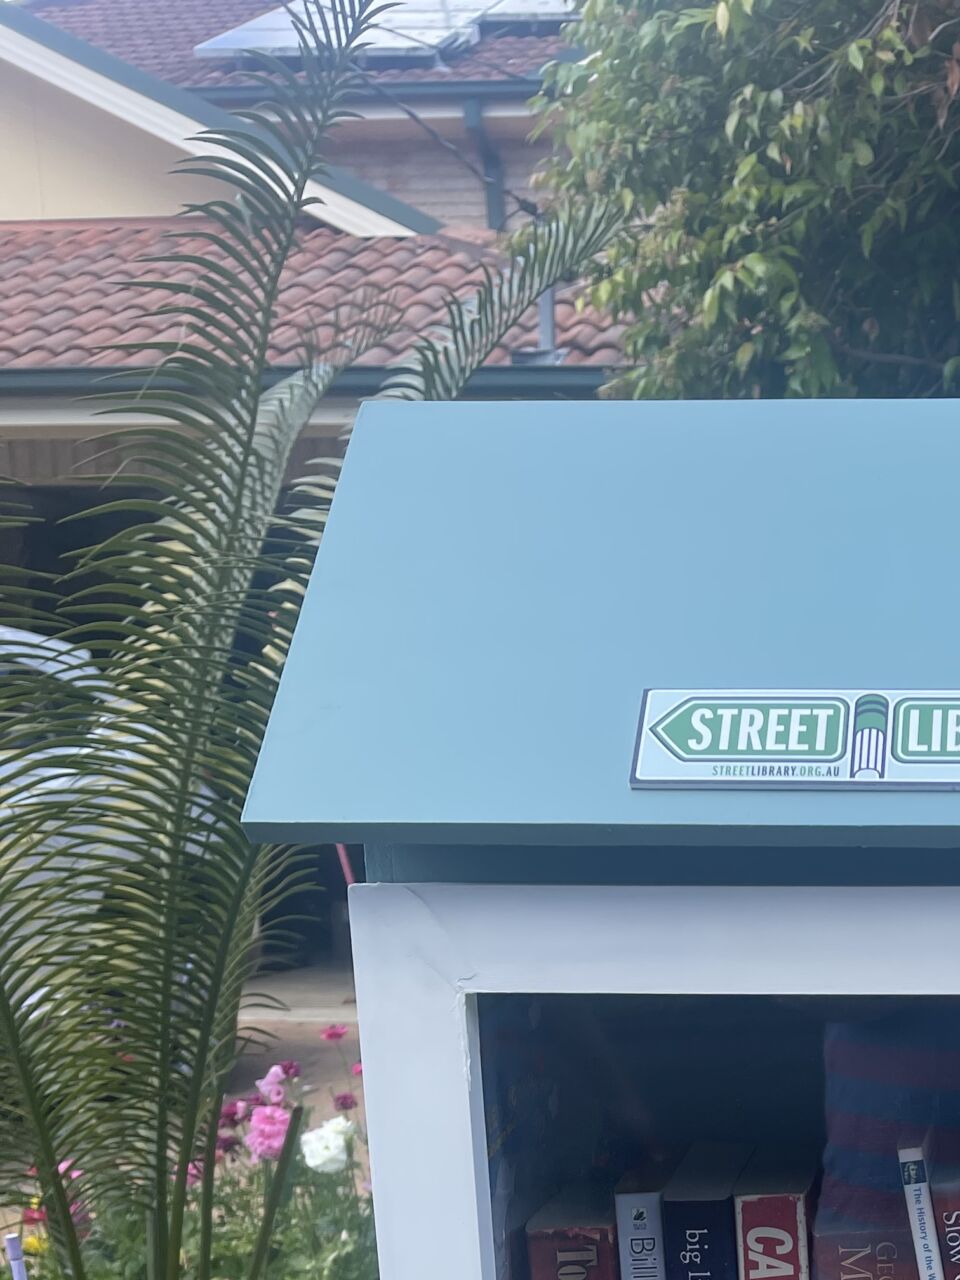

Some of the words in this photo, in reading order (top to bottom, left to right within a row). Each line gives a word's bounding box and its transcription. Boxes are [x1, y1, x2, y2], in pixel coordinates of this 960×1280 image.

[687, 708, 834, 750] STREET
[712, 765, 840, 777] STREETLIBRARY.ORG.AU
[913, 1188, 923, 1206] The
[916, 1206, 929, 1241] History
[679, 1229, 709, 1264] big
[923, 1243, 933, 1253] of
[925, 1255, 934, 1271] the
